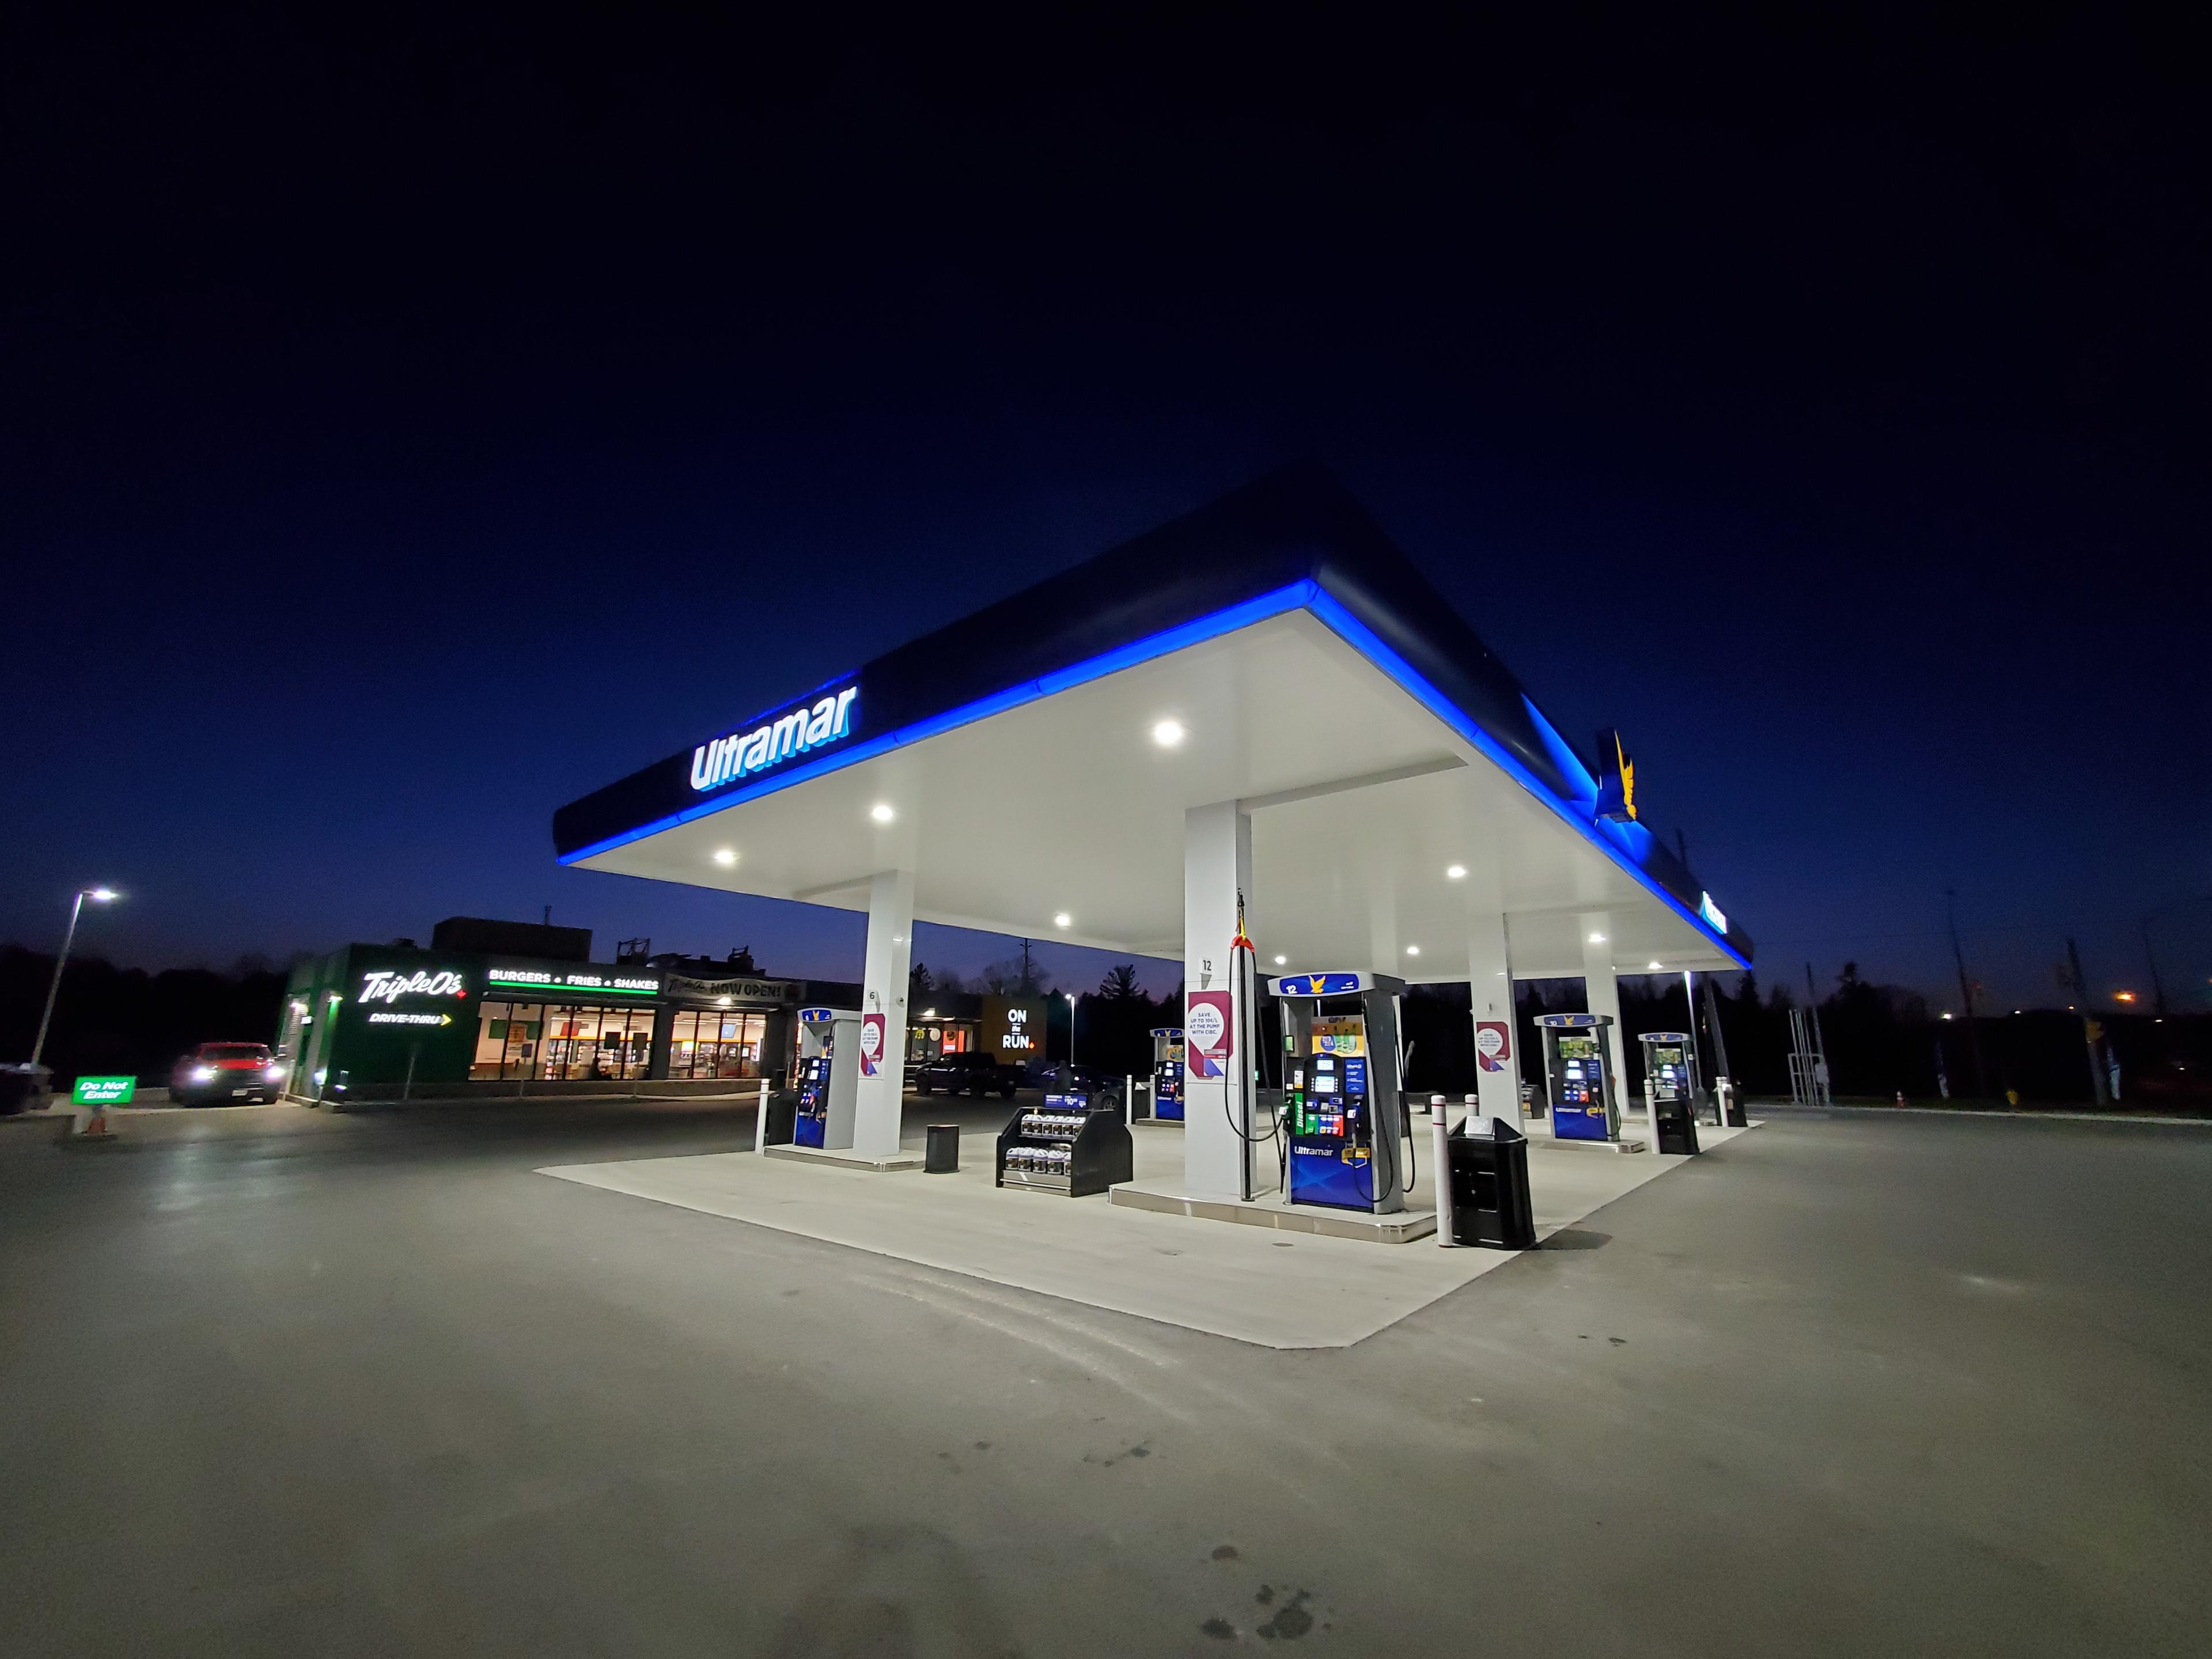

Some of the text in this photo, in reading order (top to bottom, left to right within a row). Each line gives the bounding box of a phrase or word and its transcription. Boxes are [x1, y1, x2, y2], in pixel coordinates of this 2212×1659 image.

[691, 686, 857, 791] Ultramar
[1203, 960, 1211, 971] 12
[489, 969, 551, 983] BURGERS
[567, 975, 602, 987] FRIES
[613, 978, 659, 990] SHAKES
[710, 983, 742, 995] NOW
[744, 984, 781, 997] OPEN!
[869, 991, 875, 999] 6
[1286, 985, 1297, 994] 12
[369, 1013, 441, 1024] DRIVE-THRU
[1008, 1009, 1027, 1023] ON
[1003, 1035, 1029, 1048] RUN
[79, 1082, 129, 1090] Do Not
[83, 1090, 122, 1099] Enter
[1294, 1146, 1333, 1156] Ultramar
